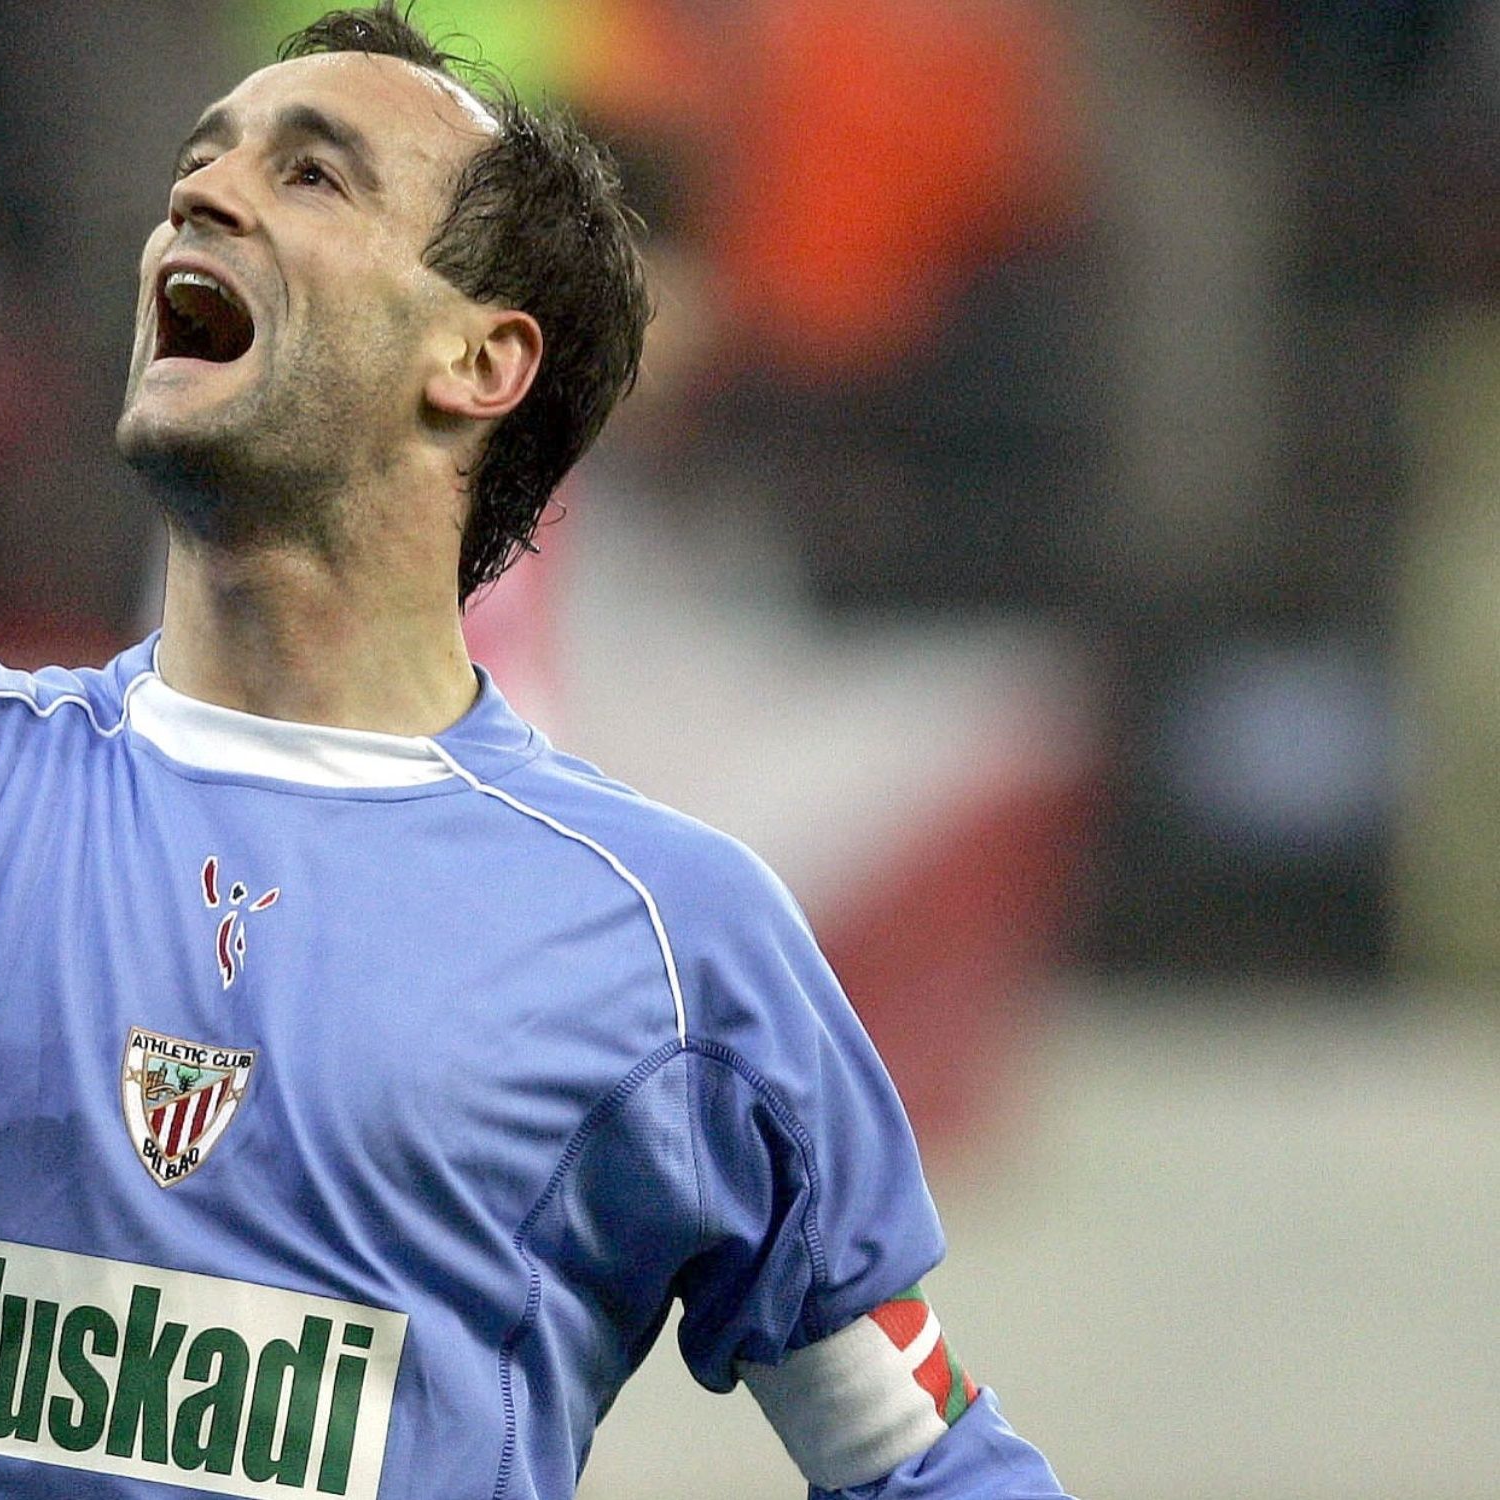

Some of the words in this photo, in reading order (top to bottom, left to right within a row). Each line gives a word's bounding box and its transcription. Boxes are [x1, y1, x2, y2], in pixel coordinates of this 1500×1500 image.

[132, 1034, 207, 1063] ATHLETIC
[213, 1050, 251, 1068] CLUB
[143, 1138, 199, 1180] BILBAO
